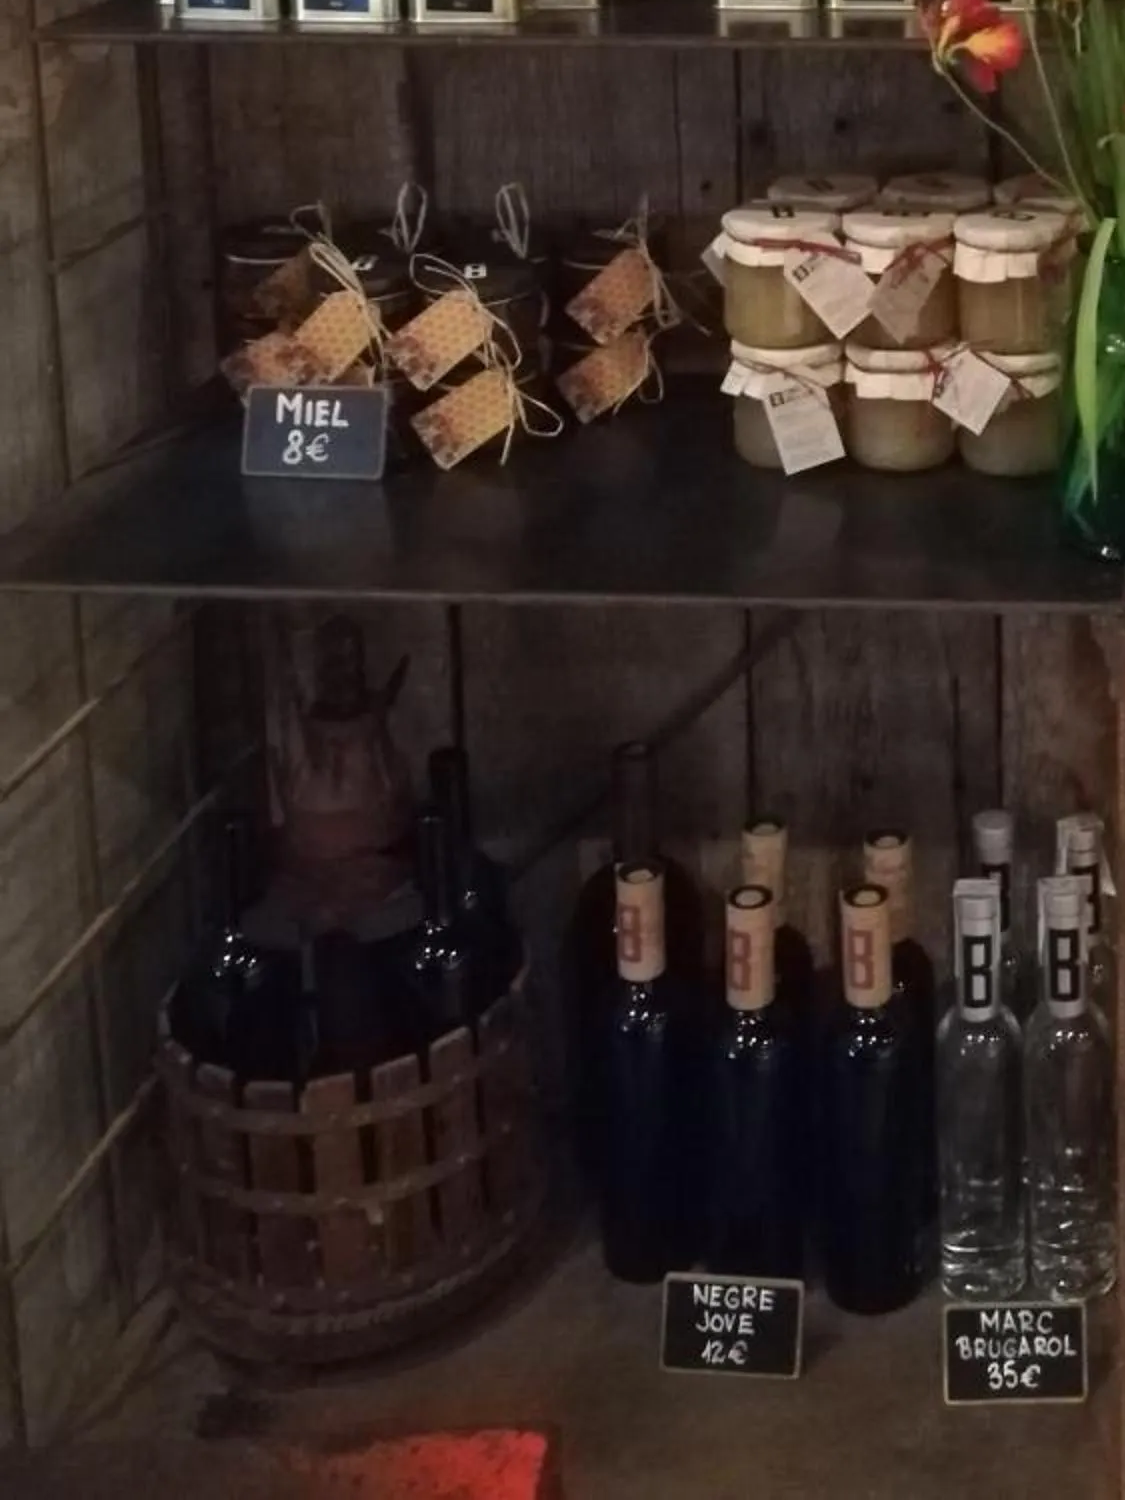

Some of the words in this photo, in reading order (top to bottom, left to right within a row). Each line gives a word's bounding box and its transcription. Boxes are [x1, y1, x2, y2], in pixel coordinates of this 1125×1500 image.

[276, 392, 349, 427] MIEL
[283, 430, 329, 464] 8€
[964, 936, 992, 1007] B
[1050, 930, 1079, 1000] B
[693, 1284, 775, 1311] NEGRE
[695, 1310, 755, 1335] JOVE
[980, 1310, 1053, 1334] MARC
[701, 1340, 748, 1365] 12€
[956, 1335, 1077, 1360] BRUGAROL
[987, 1360, 1041, 1389] 35€
